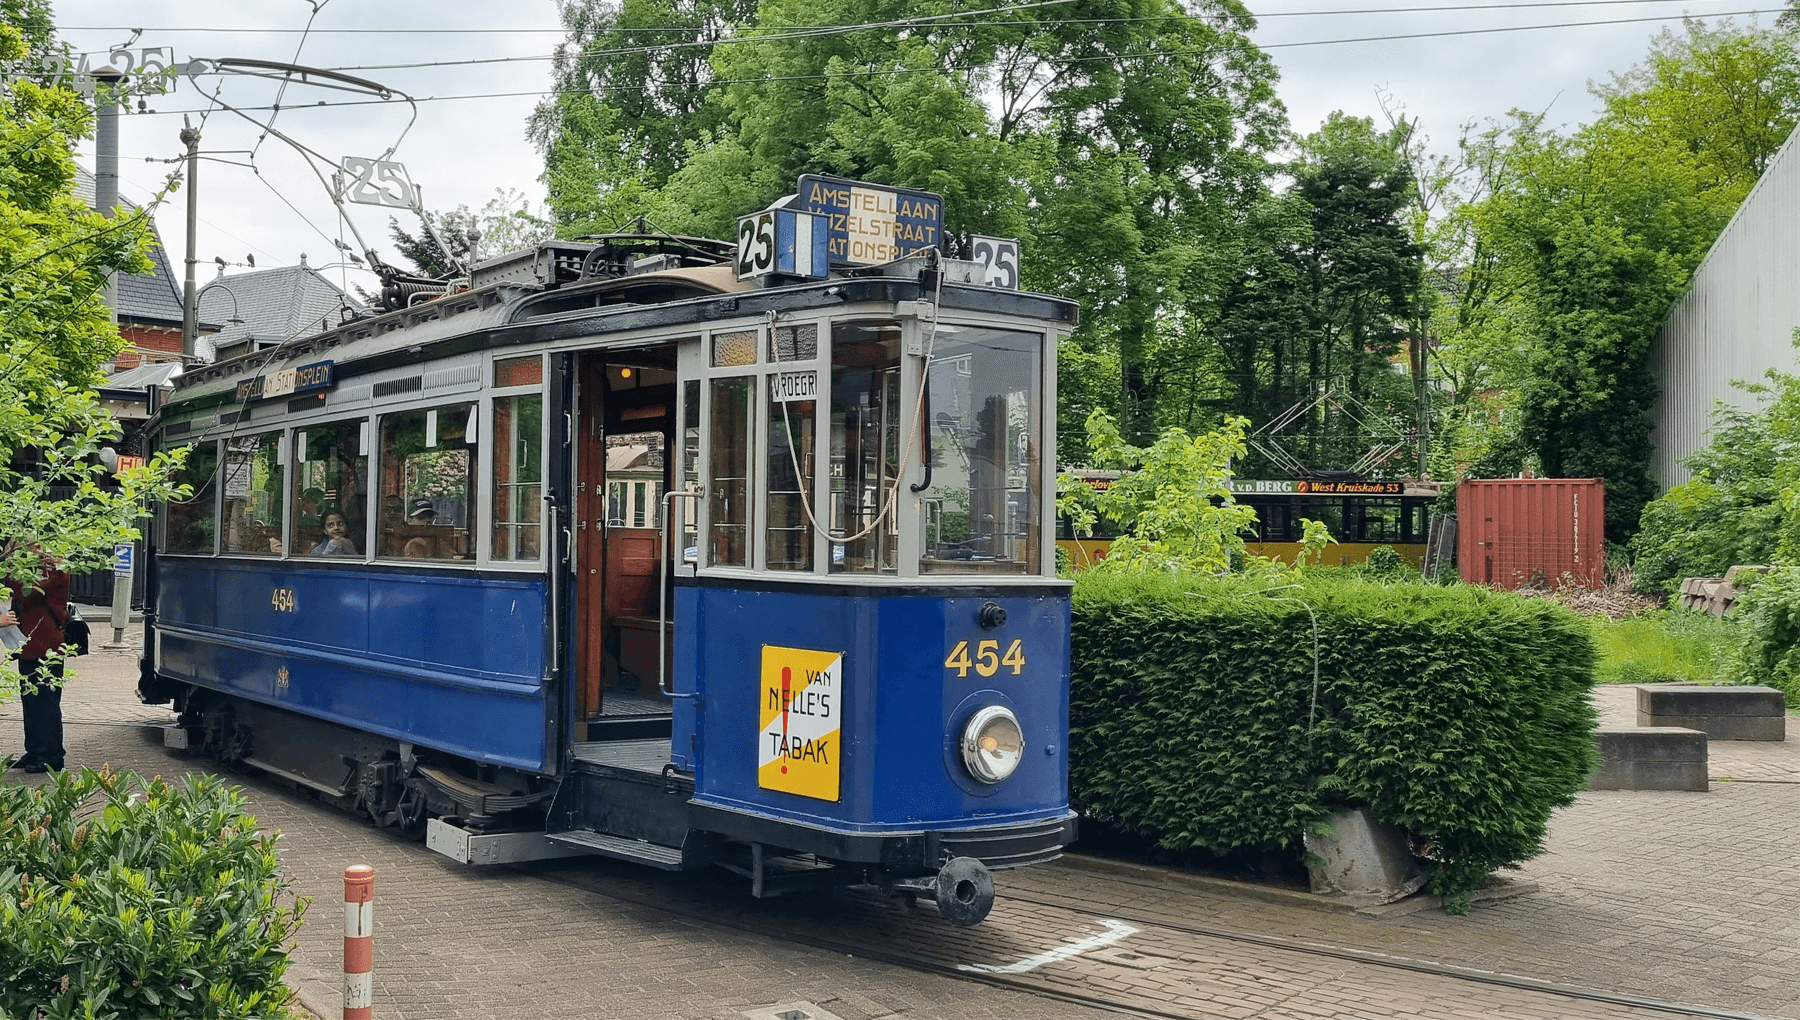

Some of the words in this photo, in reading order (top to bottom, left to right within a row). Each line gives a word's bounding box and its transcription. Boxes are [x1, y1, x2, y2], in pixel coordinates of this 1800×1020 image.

[345, 158, 412, 207] 25
[809, 183, 937, 221] AMSTELLAAN
[740, 213, 773, 276] 25
[973, 241, 1016, 289] 25
[1255, 481, 1292, 492] BERG
[1311, 482, 1334, 492] West
[1335, 482, 1384, 493] Kruiskade
[1386, 483, 1399, 493] 53
[271, 588, 294, 613] 454
[944, 639, 1026, 678] 454
[806, 668, 831, 687] VAN
[768, 687, 830, 718] NELLE'S
[768, 732, 829, 765] TABAK
